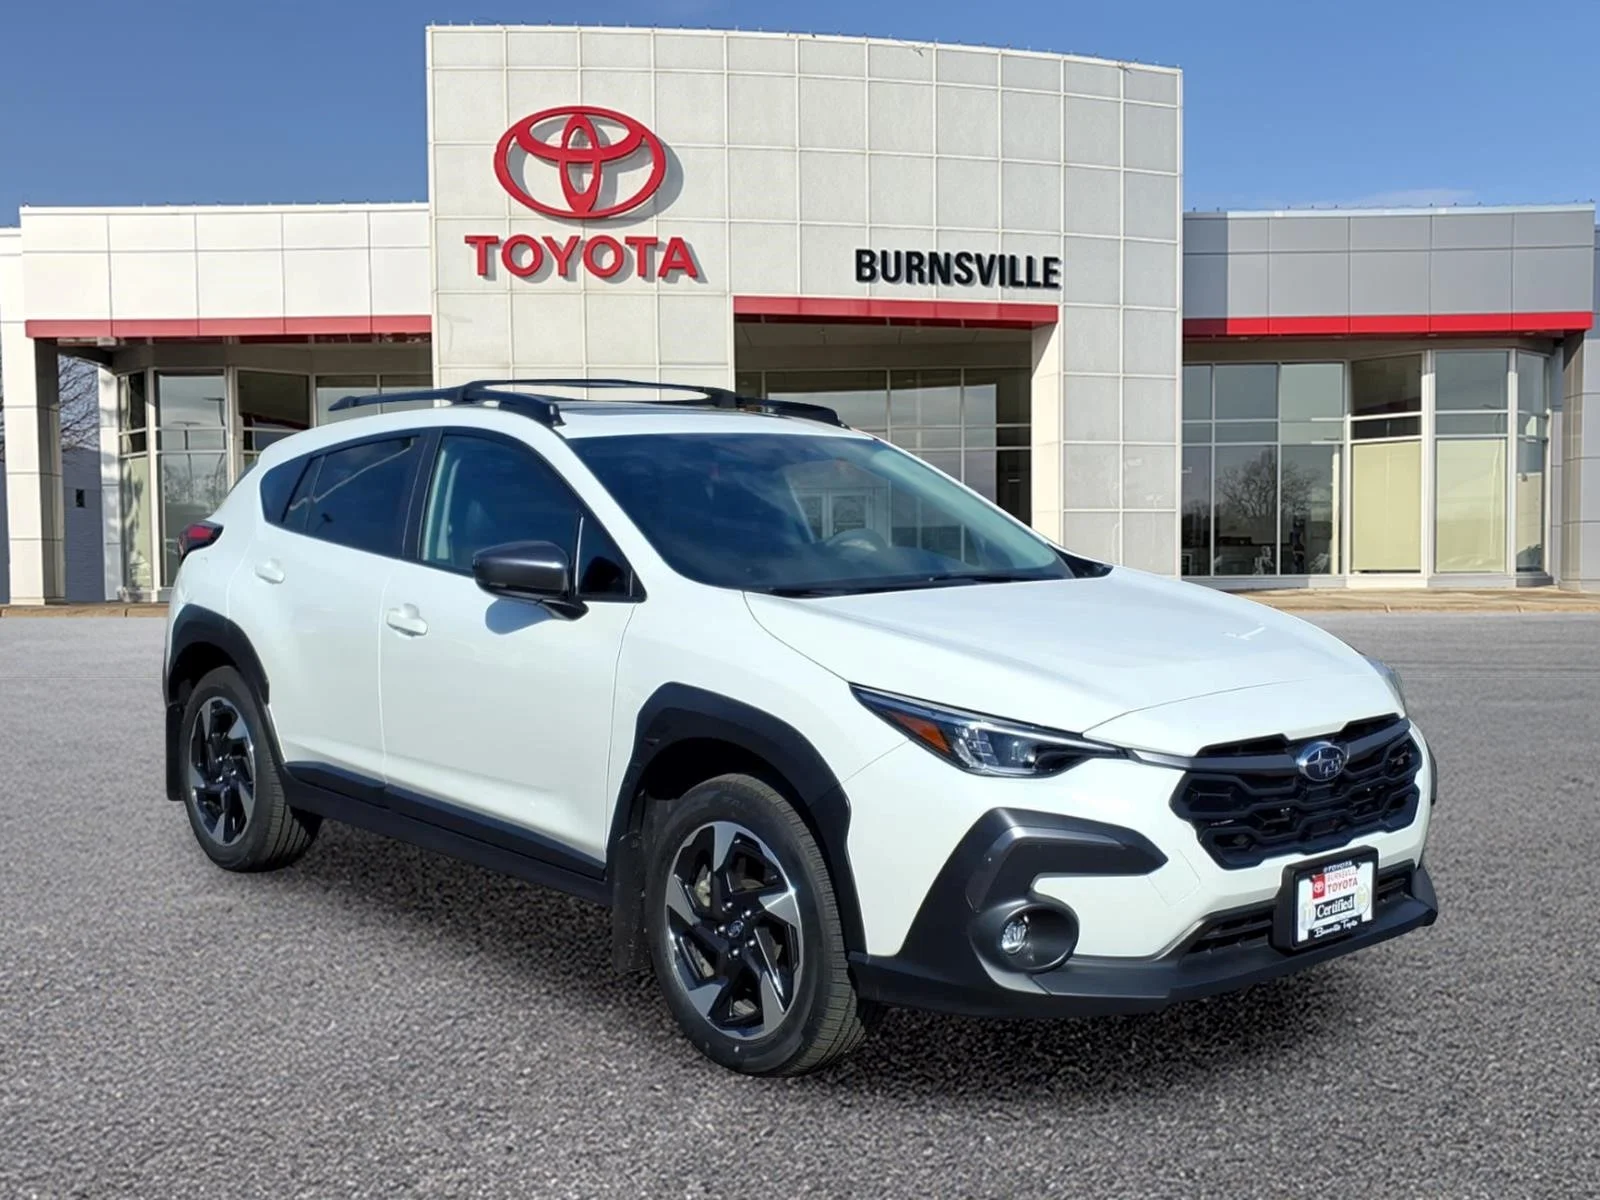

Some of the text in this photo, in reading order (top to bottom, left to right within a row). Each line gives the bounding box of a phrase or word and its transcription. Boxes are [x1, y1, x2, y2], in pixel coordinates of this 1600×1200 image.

[464, 234, 698, 278] TOYOTA
[855, 248, 1061, 289] BURNSVILLE
[1328, 877, 1358, 893] TOYOTA
[1317, 896, 1353, 917] Certified
